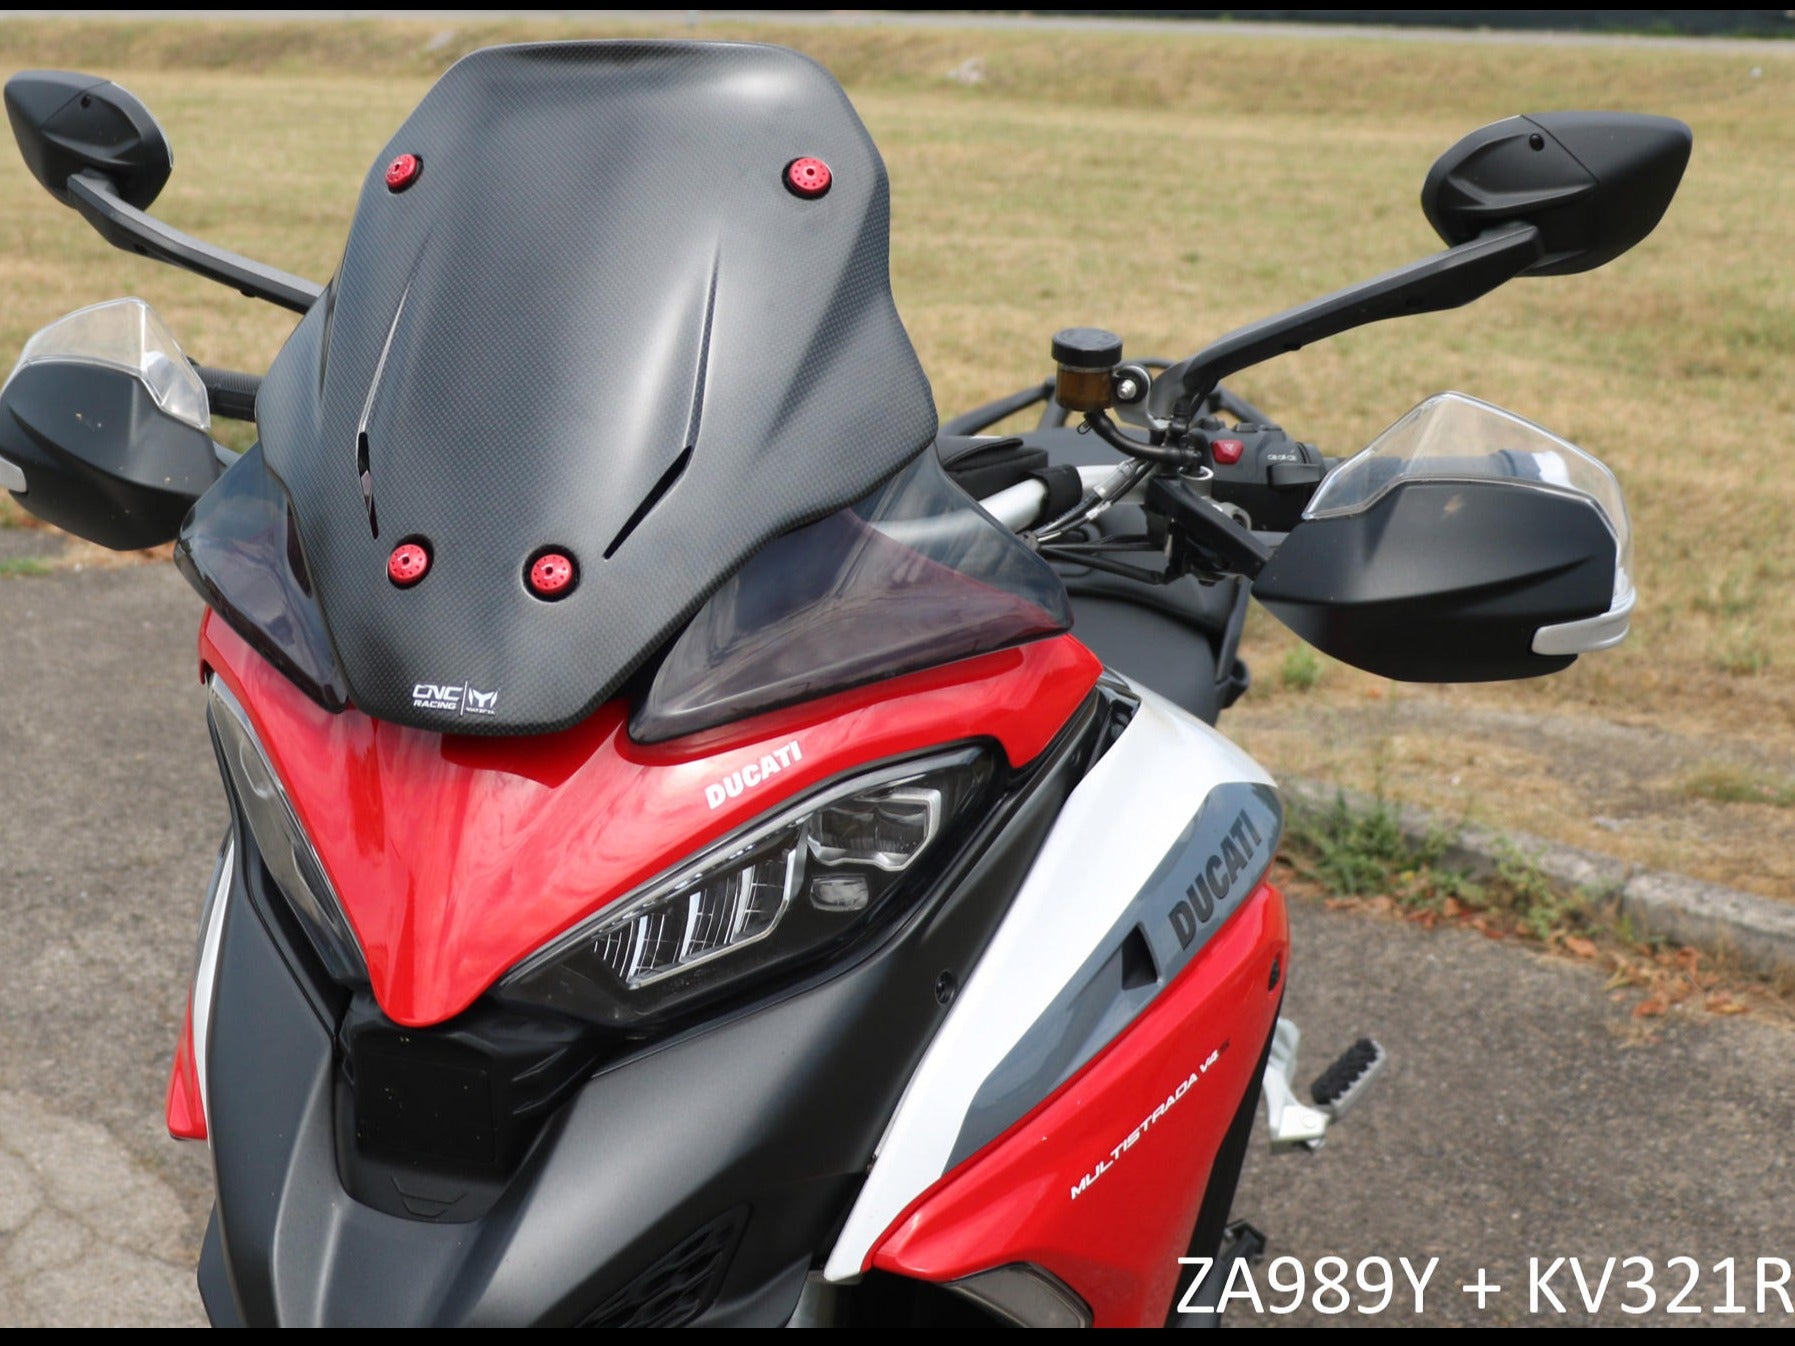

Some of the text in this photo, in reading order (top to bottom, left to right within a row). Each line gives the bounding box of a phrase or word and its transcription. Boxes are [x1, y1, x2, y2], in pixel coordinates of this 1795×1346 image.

[412, 684, 464, 702] CNC
[413, 699, 457, 710] RACING
[704, 740, 803, 810] DUCATI
[1167, 808, 1262, 951] DUCATI
[1070, 1072, 1198, 1200] MULTISTRADA
